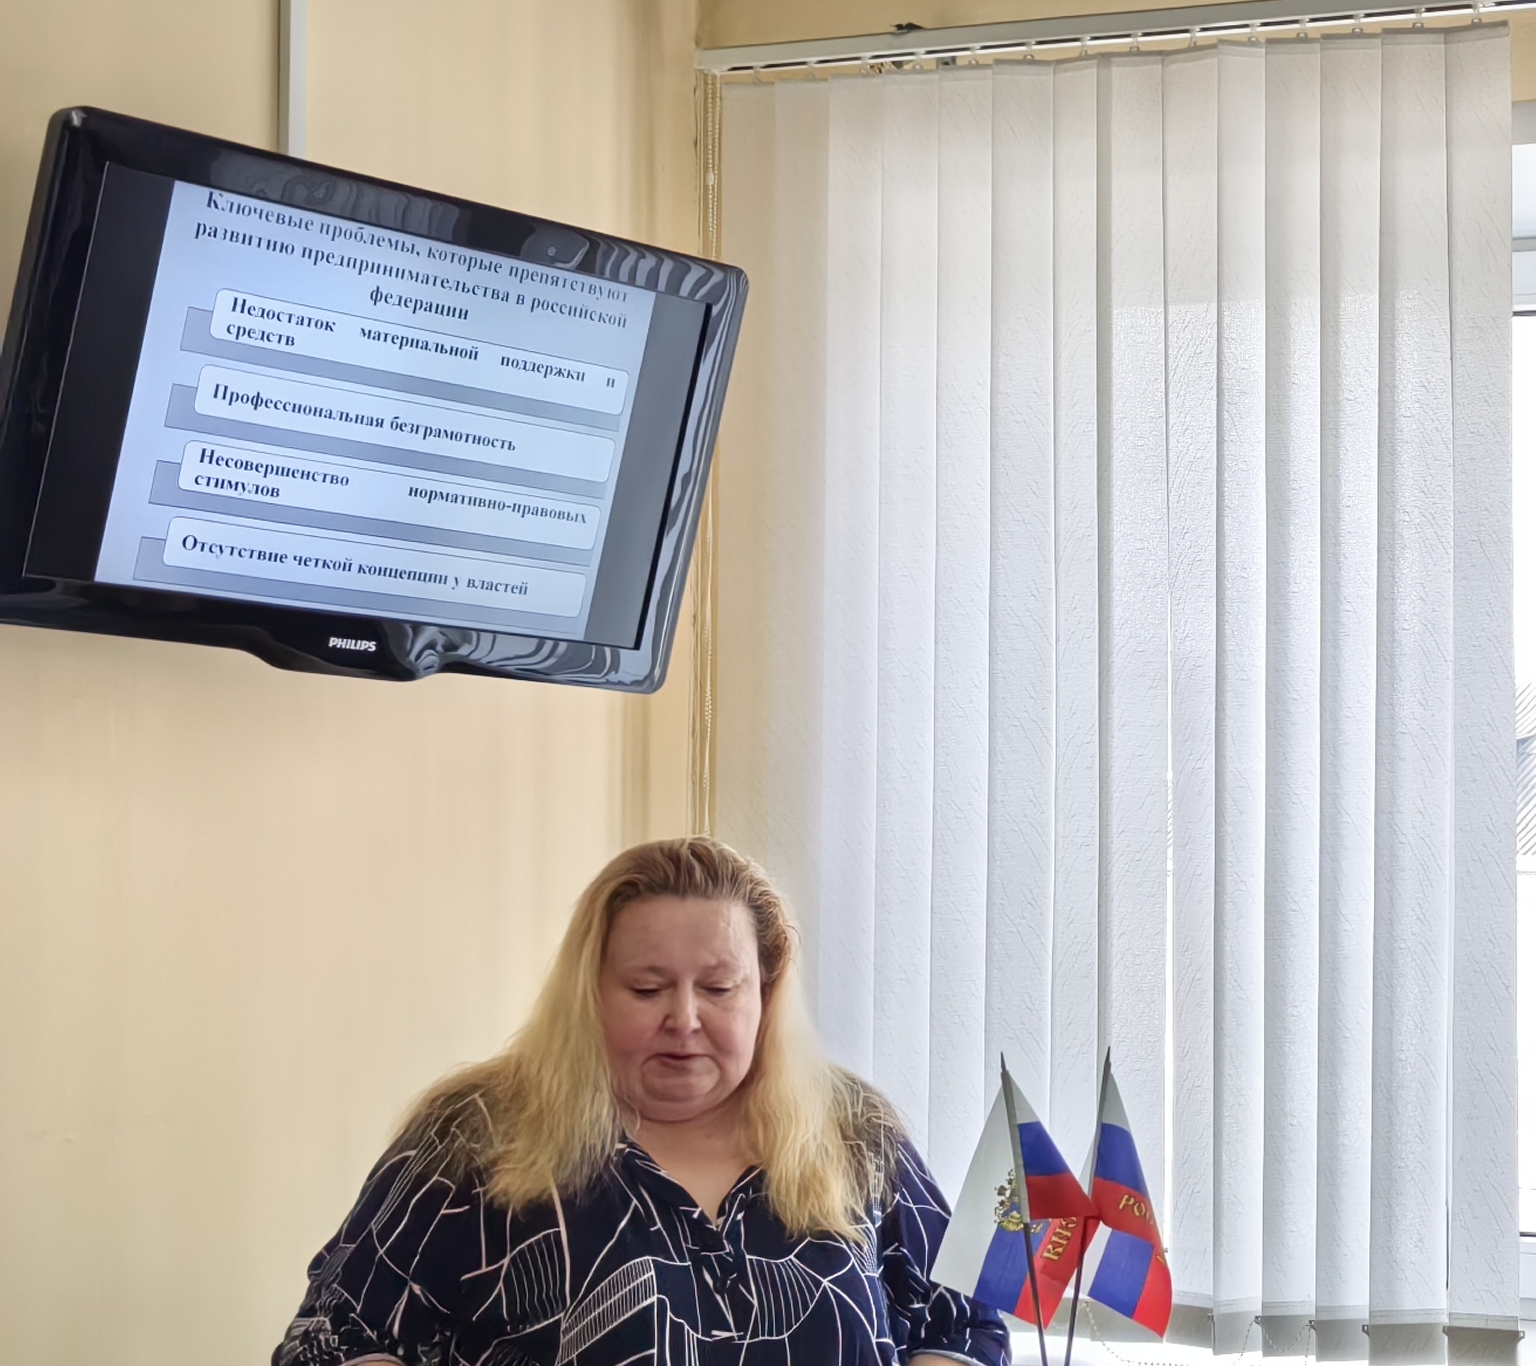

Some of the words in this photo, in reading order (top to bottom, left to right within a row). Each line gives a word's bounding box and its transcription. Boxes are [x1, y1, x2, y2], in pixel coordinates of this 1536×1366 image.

[194, 221, 296, 256] развитию
[301, 245, 510, 303] предпринимательства
[516, 296, 525, 306] в
[530, 297, 628, 329] российской
[206, 190, 315, 232] Ключевые
[319, 220, 421, 257] проблемы,
[427, 246, 503, 274] которые
[509, 263, 628, 303] препятствуют
[226, 322, 296, 347] средств
[370, 285, 469, 322] федерации
[231, 296, 337, 333] Недостаток
[360, 326, 479, 362] материальной
[500, 354, 586, 383] поддержки
[606, 377, 616, 388] и
[212, 383, 385, 429] Профессиональная
[390, 416, 517, 452] безграмотность
[194, 473, 281, 498] стимулов
[199, 447, 350, 487] Несовершенство
[408, 486, 588, 525] нормативно-правовых
[181, 534, 289, 565] Отсутствие
[293, 555, 354, 573] четкой
[357, 563, 449, 586] концепции
[451, 575, 460, 590] у
[467, 577, 529, 596] властей
[328, 636, 377, 652] PHILIPS
